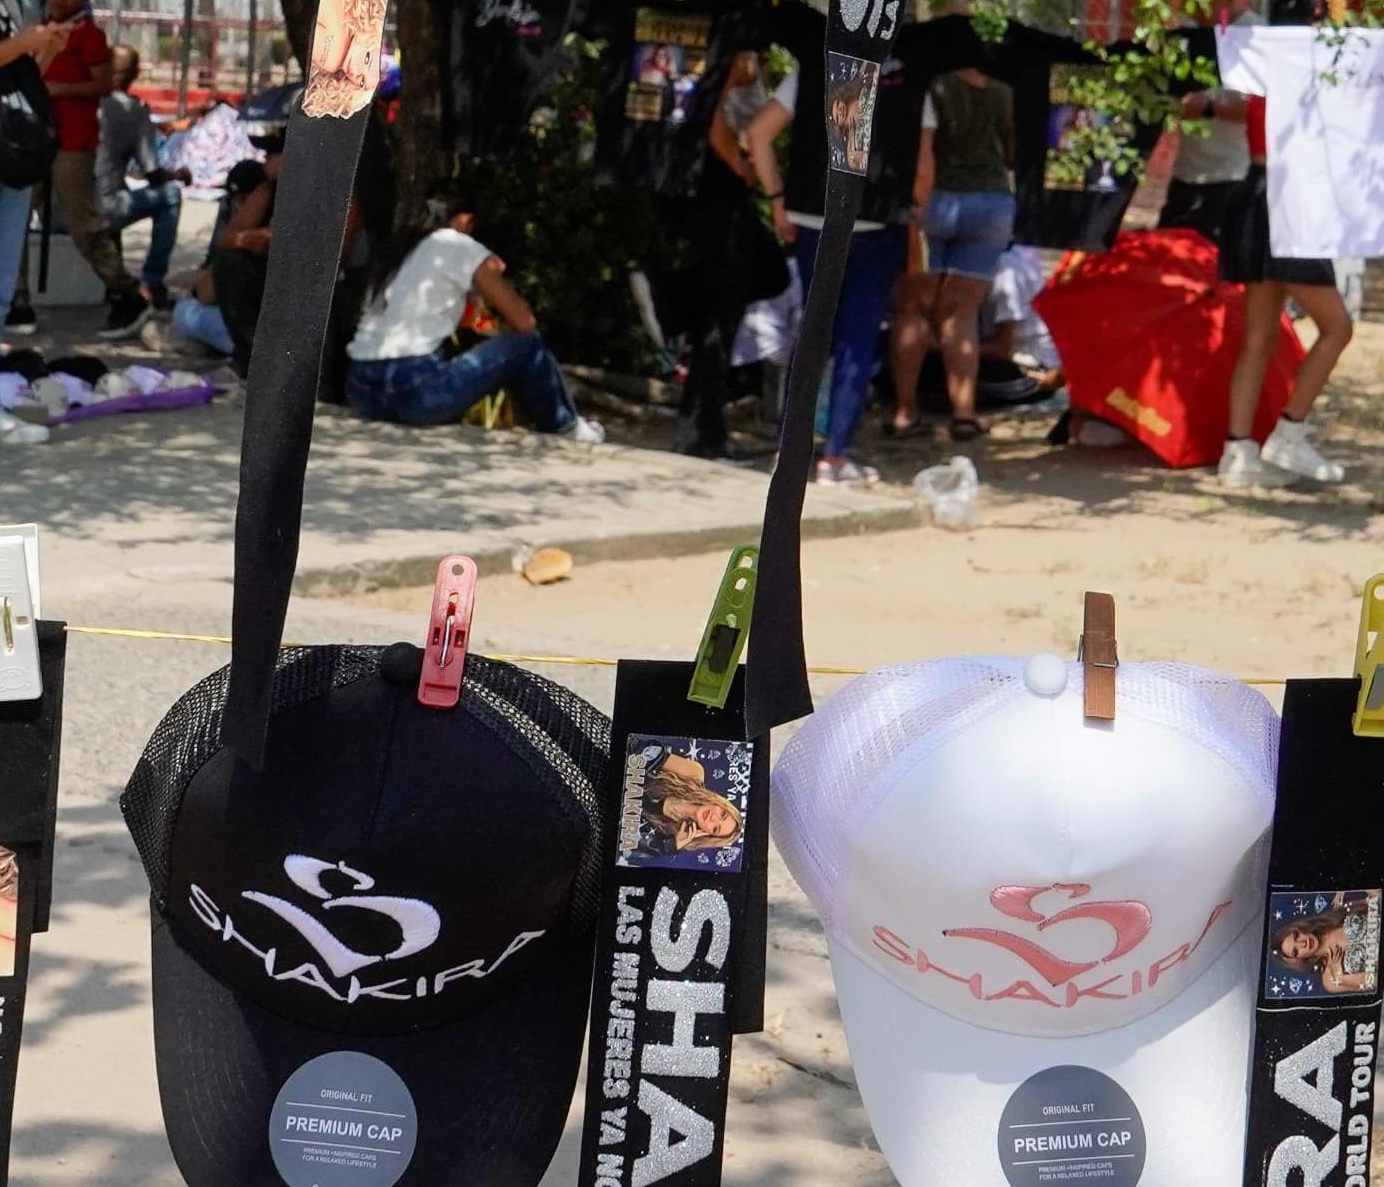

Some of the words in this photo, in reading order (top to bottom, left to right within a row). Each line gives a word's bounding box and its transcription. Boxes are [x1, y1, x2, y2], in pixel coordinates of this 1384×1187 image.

[618, 753, 647, 851] SHAKIRA
[616, 885, 645, 946] LAS
[602, 950, 639, 1100] MUJERES
[1349, 1021, 1376, 1109] TOUR
[320, 1088, 358, 1103] ORIGINAL
[359, 1092, 373, 1104] FIT
[1042, 1104, 1081, 1116] ORIGINAL
[1082, 1103, 1095, 1113] FIT
[285, 1115, 363, 1138] PREMIUM
[366, 1124, 403, 1142] CAP
[598, 1105, 628, 1146] YA
[1014, 1133, 1093, 1153] PREMIUM
[1097, 1131, 1132, 1147] CAP
